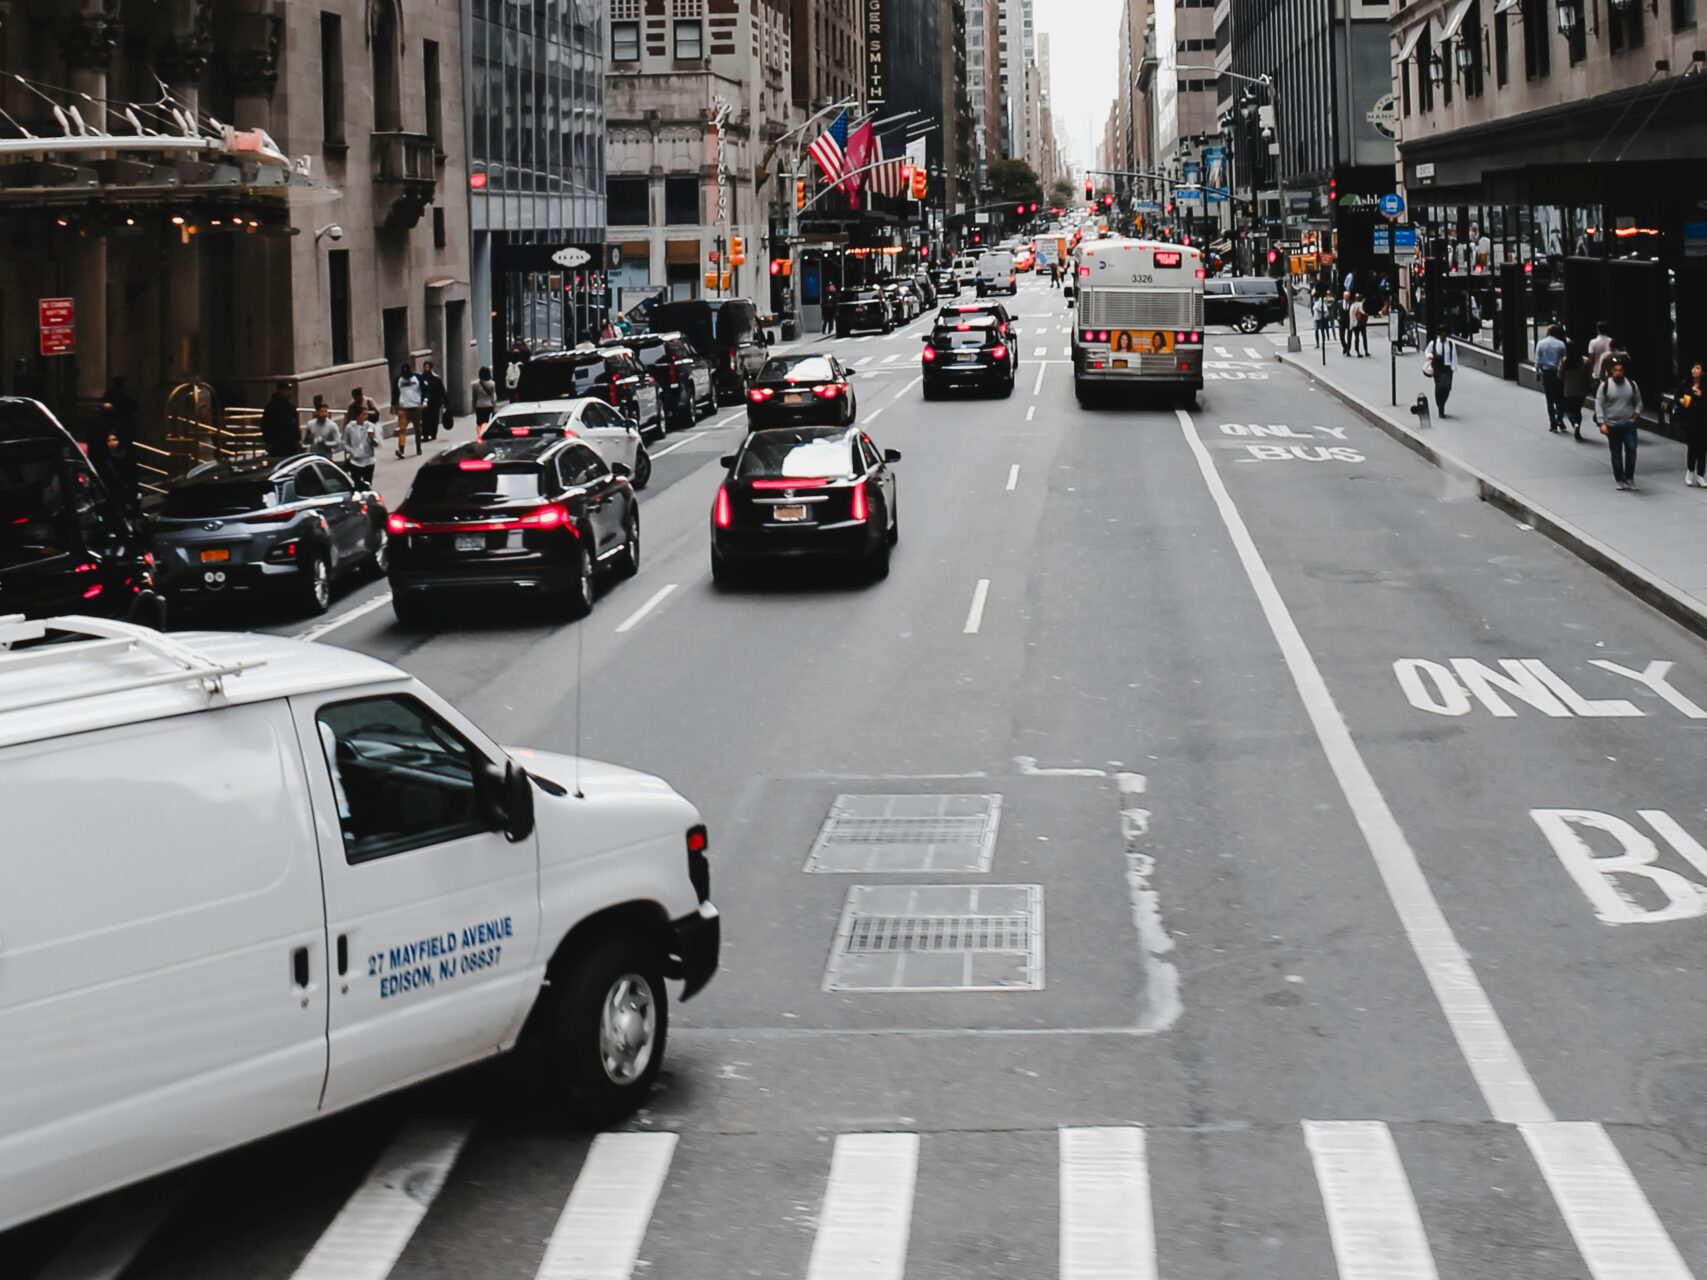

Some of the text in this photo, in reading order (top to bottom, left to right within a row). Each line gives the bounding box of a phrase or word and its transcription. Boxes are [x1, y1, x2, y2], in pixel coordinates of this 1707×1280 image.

[870, 40, 882, 97] SMITH
[708, 104, 732, 219] LEXINGTON
[1132, 274, 1153, 283] 3326
[1219, 423, 1348, 439] ONLY
[1245, 445, 1366, 463] BUS
[1392, 658, 1707, 718] ONLY
[368, 916, 513, 976] 27 MAYFIELD AVENUE
[380, 946, 502, 998] EDISON, NJ 08837
